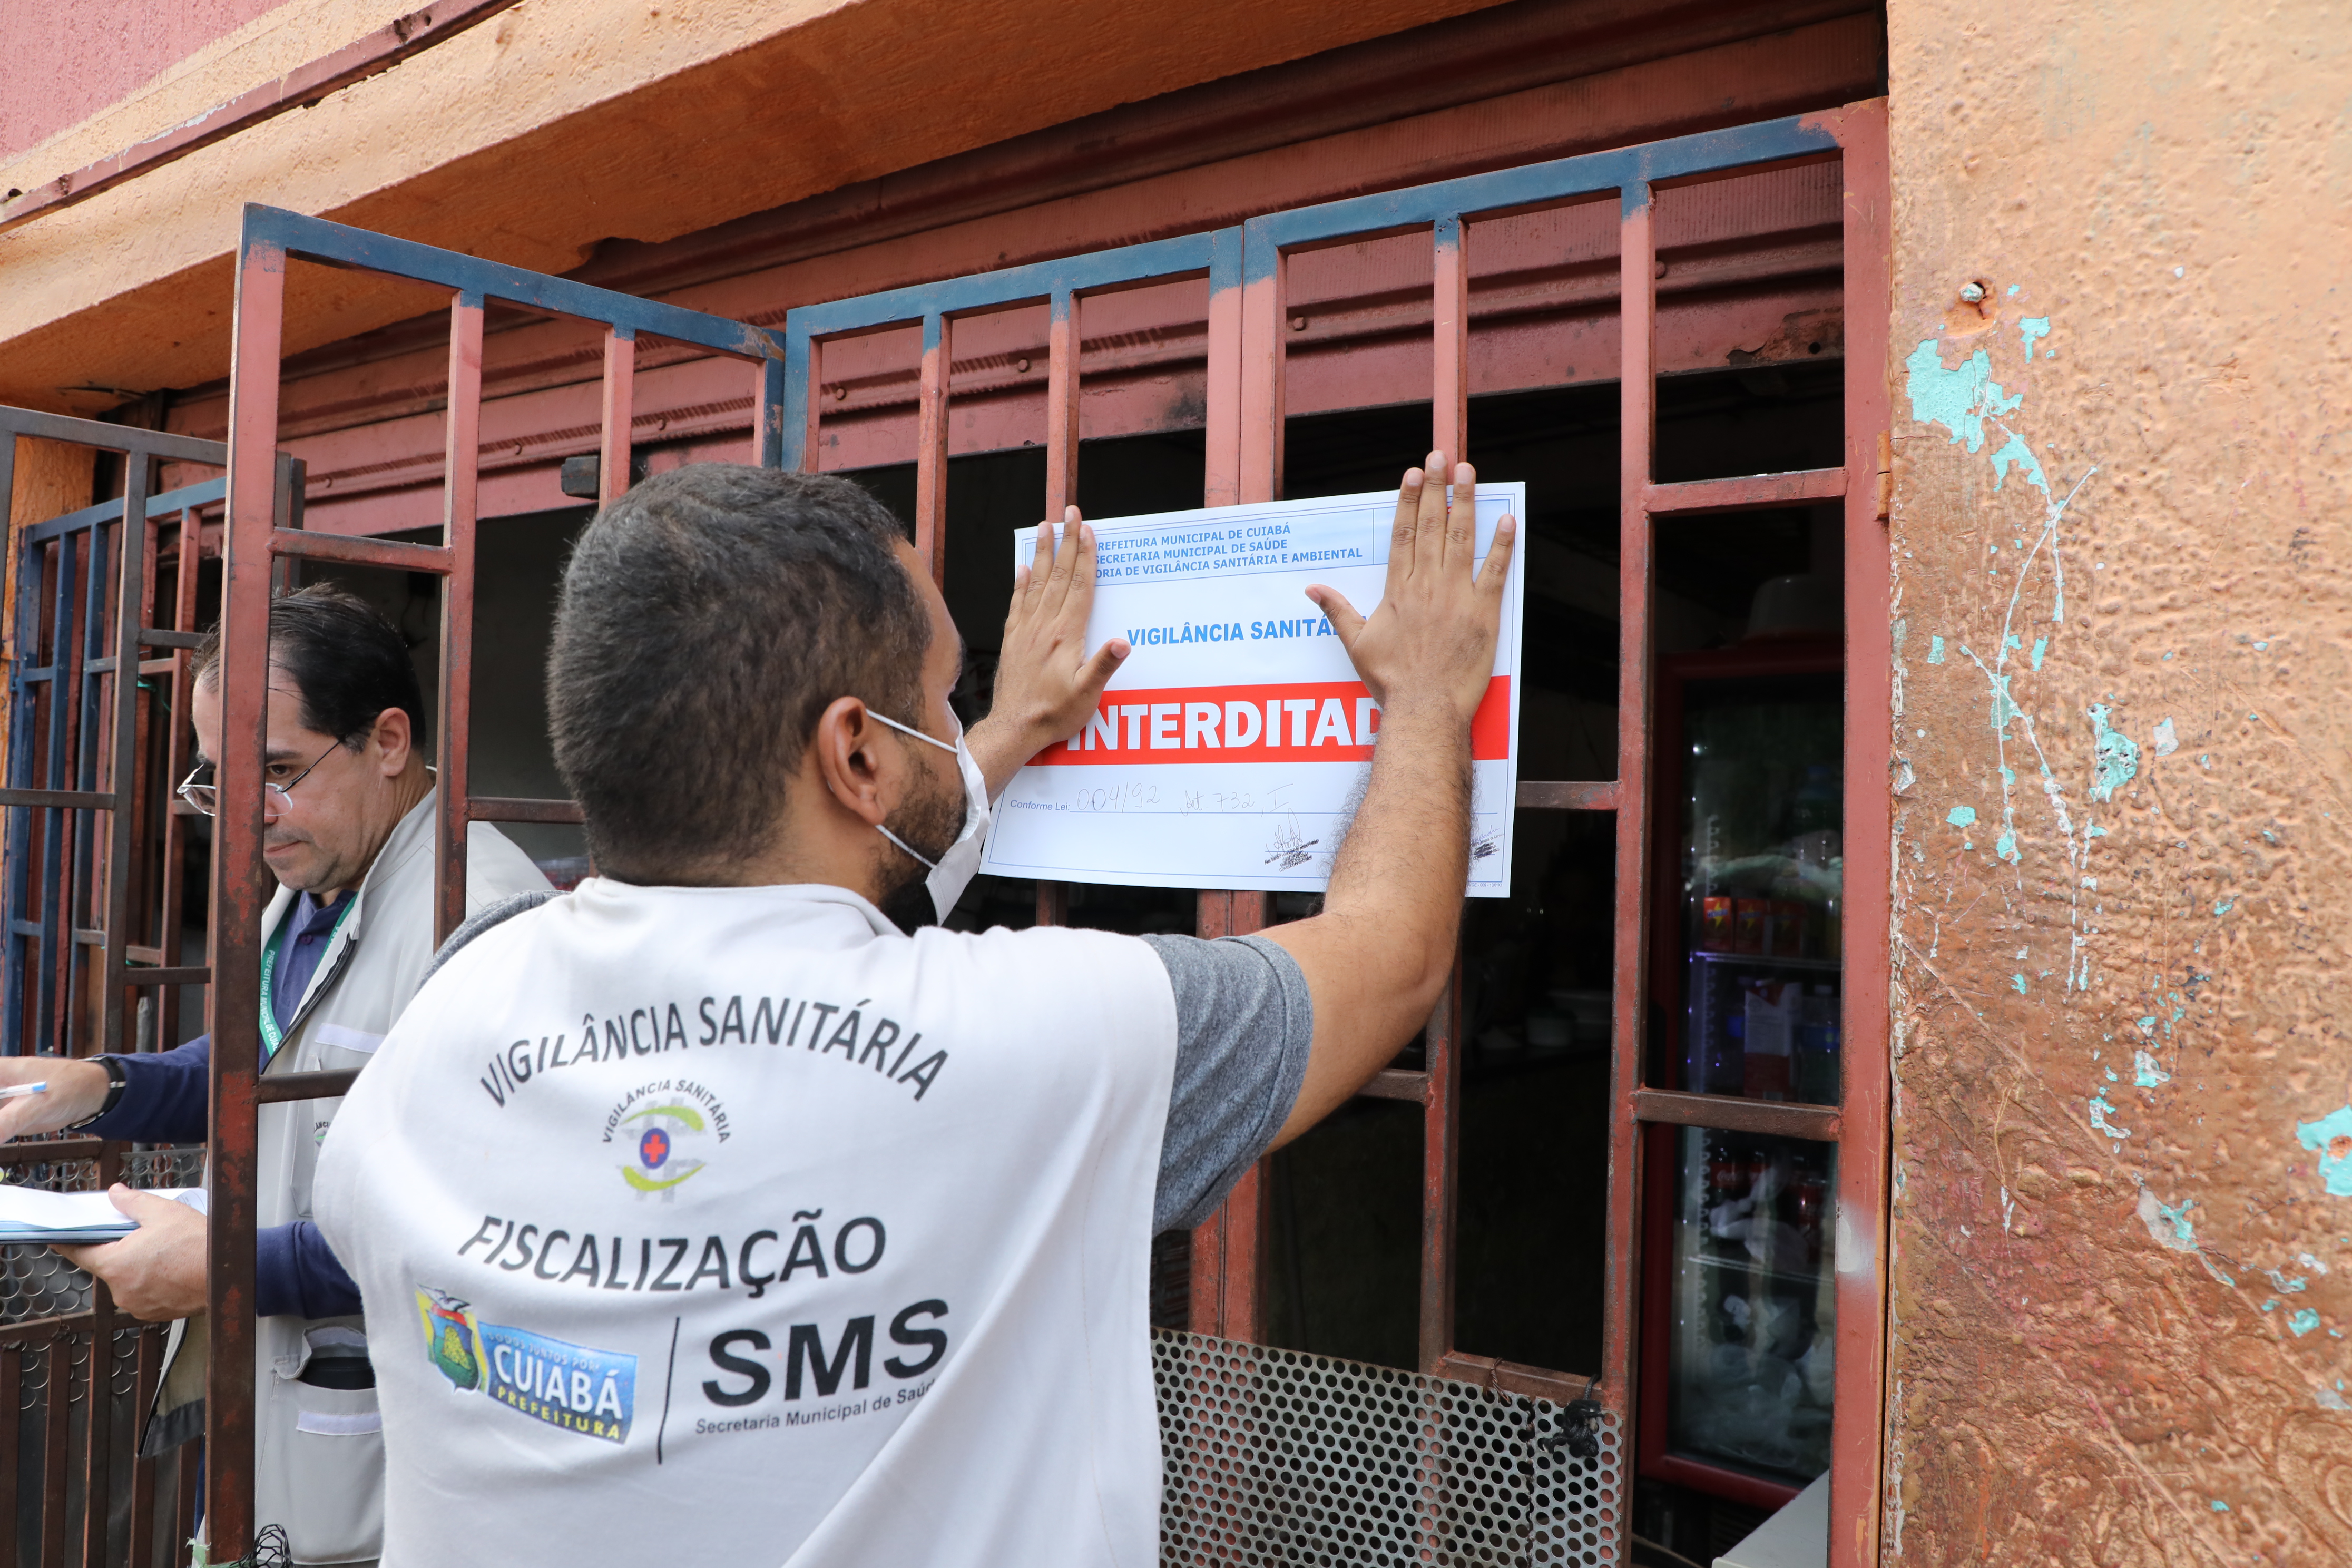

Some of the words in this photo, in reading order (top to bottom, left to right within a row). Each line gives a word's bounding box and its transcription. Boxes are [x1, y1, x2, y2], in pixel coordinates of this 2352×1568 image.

[1096, 537, 1158, 551] REFEITURA
[1161, 531, 1224, 545] MUNICIPAL
[1228, 529, 1243, 540] DE
[1247, 522, 1291, 537] CUIABÁ
[1163, 545, 1228, 559] MUNICIPAL
[1231, 543, 1246, 553] DE
[1249, 538, 1287, 551] SAÚDE
[1125, 566, 1139, 576] DE
[1143, 560, 1210, 574] VIGILÂNCIA
[1213, 554, 1278, 569] SANITÁRIA
[1281, 554, 1288, 564] E
[1291, 548, 1363, 563] AMBIENTAL
[1126, 622, 1244, 646] VIGILÂNCIA
[1251, 613, 1367, 639] SANITÁ
[1010, 799, 1053, 811] Conforme
[1055, 801, 1070, 811] Lei:
[1076, 781, 1160, 813] 004/92
[261, 950, 276, 995] PREFEITURA
[265, 1024, 275, 1033] DE
[479, 1002, 688, 1108] VIGILÂNCIA
[699, 995, 948, 1102] SANITÁRIA
[603, 1079, 670, 1143] VIGILÂNCIA
[675, 1079, 731, 1144] SANITÁRIA
[457, 1208, 886, 1298] FISCALIZAÇÃO
[528, 1343, 568, 1366] JUNTOS
[702, 1298, 949, 1408] SMS
[493, 1343, 623, 1420] CUIABÁ
[497, 1385, 620, 1440] PREFEITURA
[695, 1414, 780, 1434] Secretaria
[786, 1400, 867, 1427] Municipal
[873, 1395, 891, 1411] de
